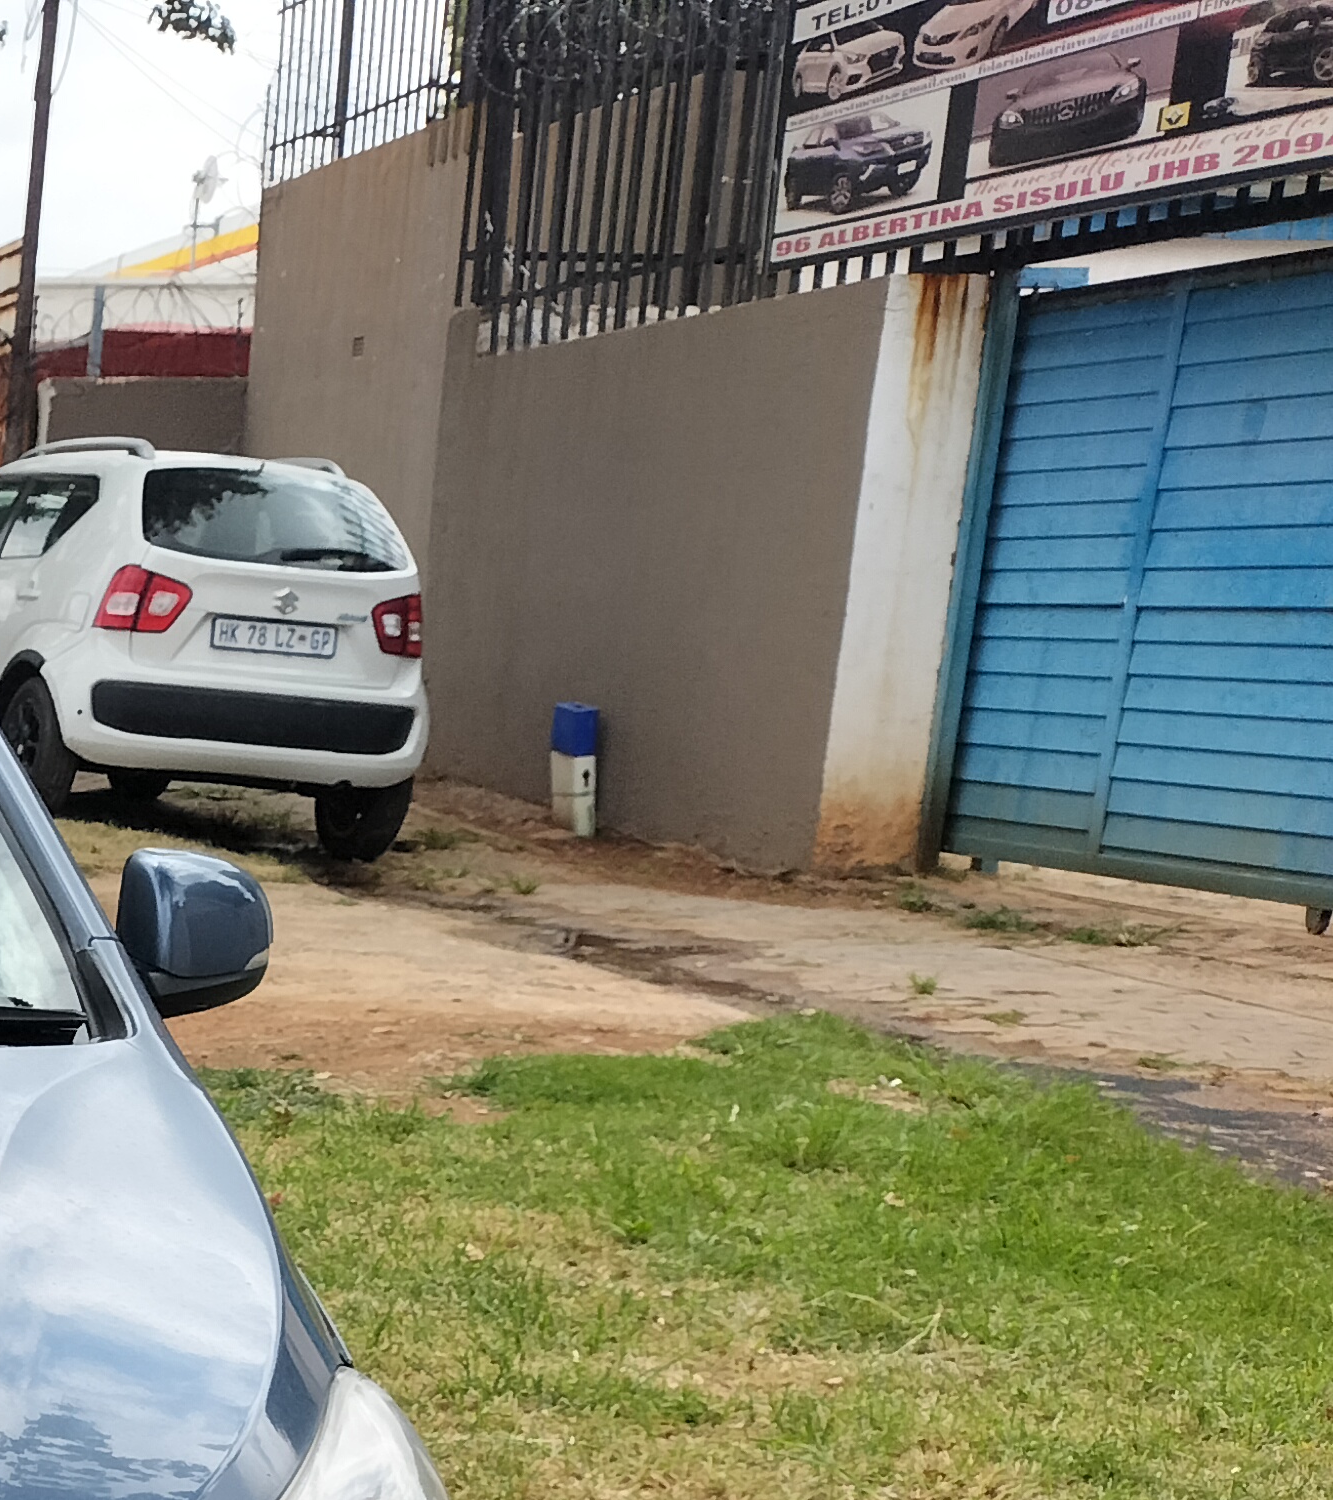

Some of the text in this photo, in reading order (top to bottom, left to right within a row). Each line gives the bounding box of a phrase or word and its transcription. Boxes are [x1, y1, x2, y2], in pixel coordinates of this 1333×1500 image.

[776, 236, 811, 257] 96
[818, 201, 984, 249] ALBERTINA
[993, 171, 1125, 213] SISULU
[218, 620, 331, 651] HK 78 LZ GP
